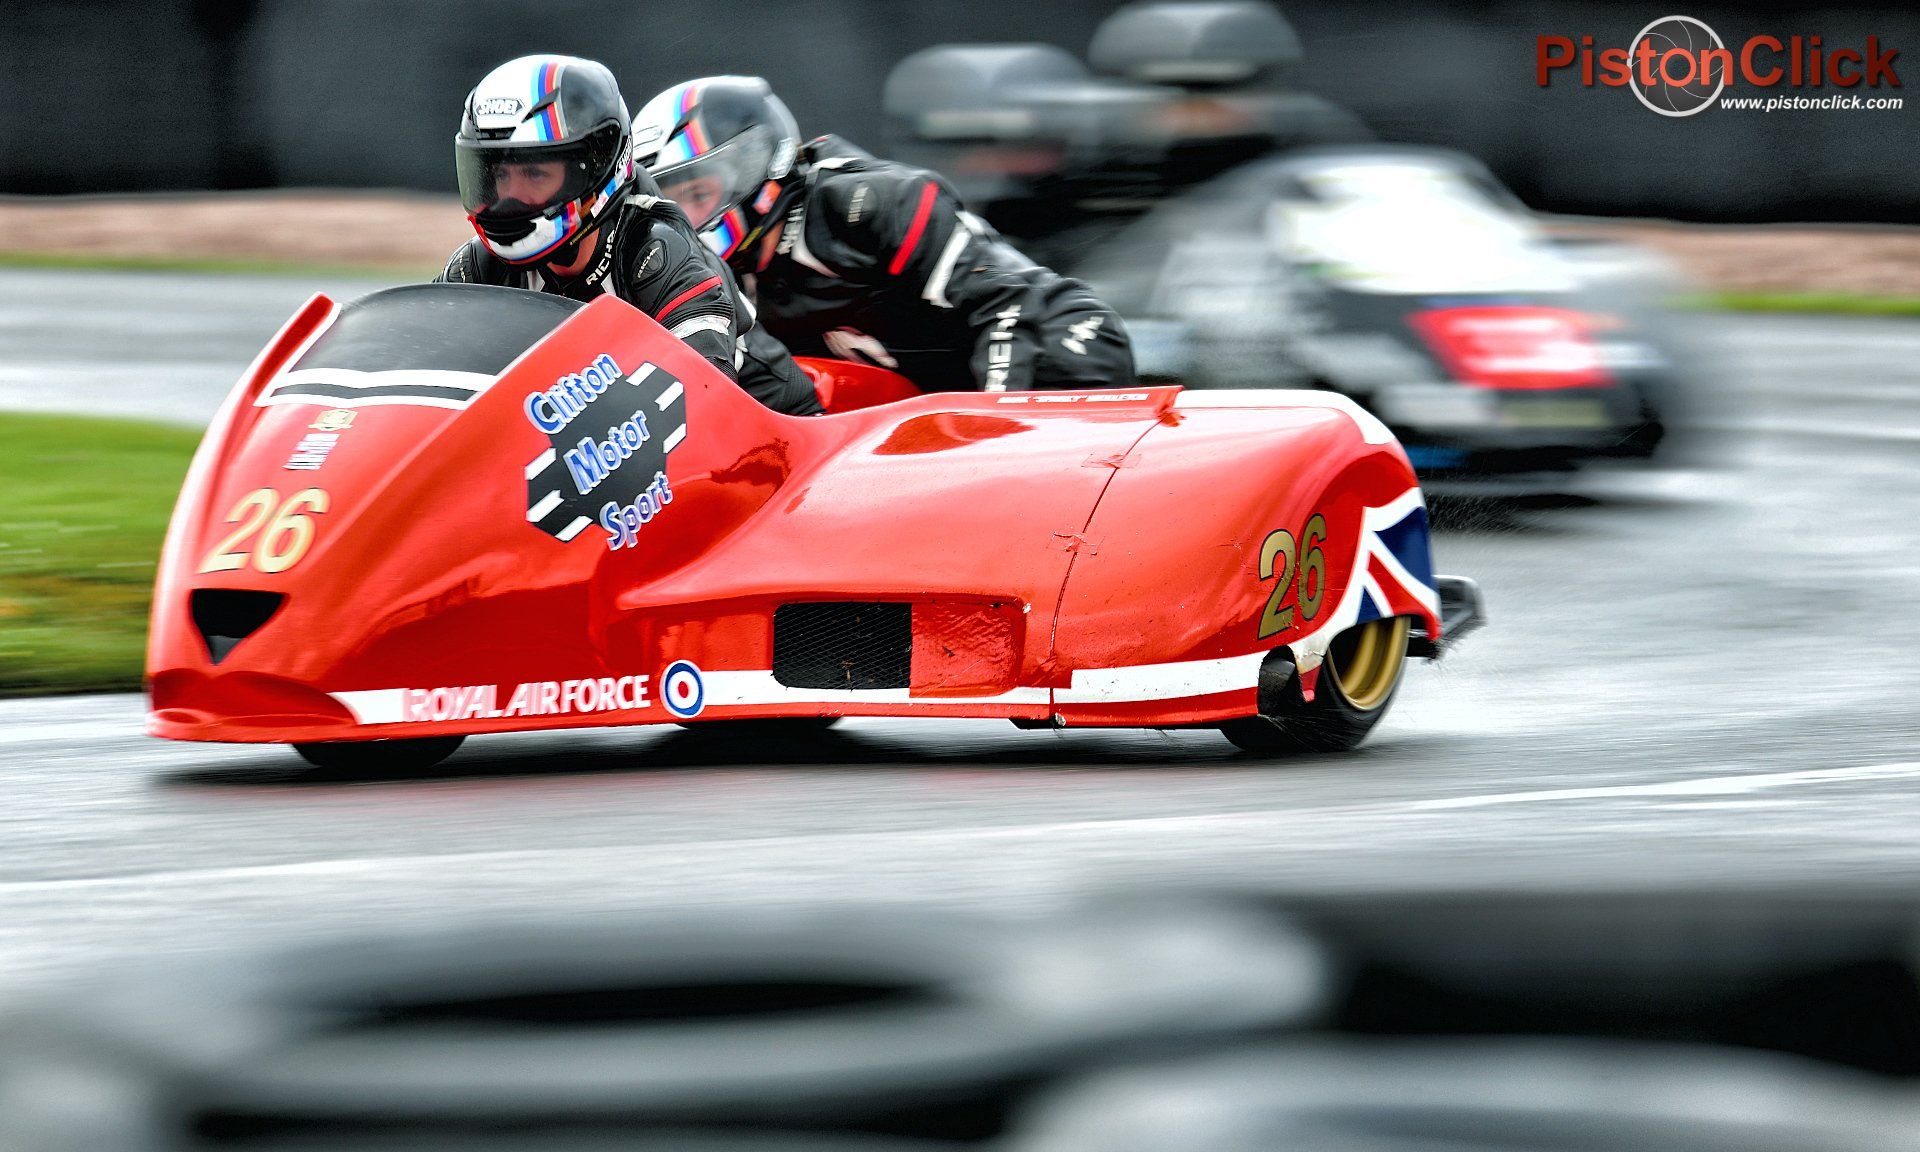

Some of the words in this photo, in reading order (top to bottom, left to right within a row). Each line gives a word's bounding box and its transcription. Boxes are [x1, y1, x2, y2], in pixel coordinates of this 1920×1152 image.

[523, 353, 623, 434] Clifton
[563, 410, 651, 496] Motor
[195, 487, 331, 574] 26
[599, 470, 673, 551] Sport
[1257, 513, 1327, 641] 26
[402, 685, 503, 722] ROYAL
